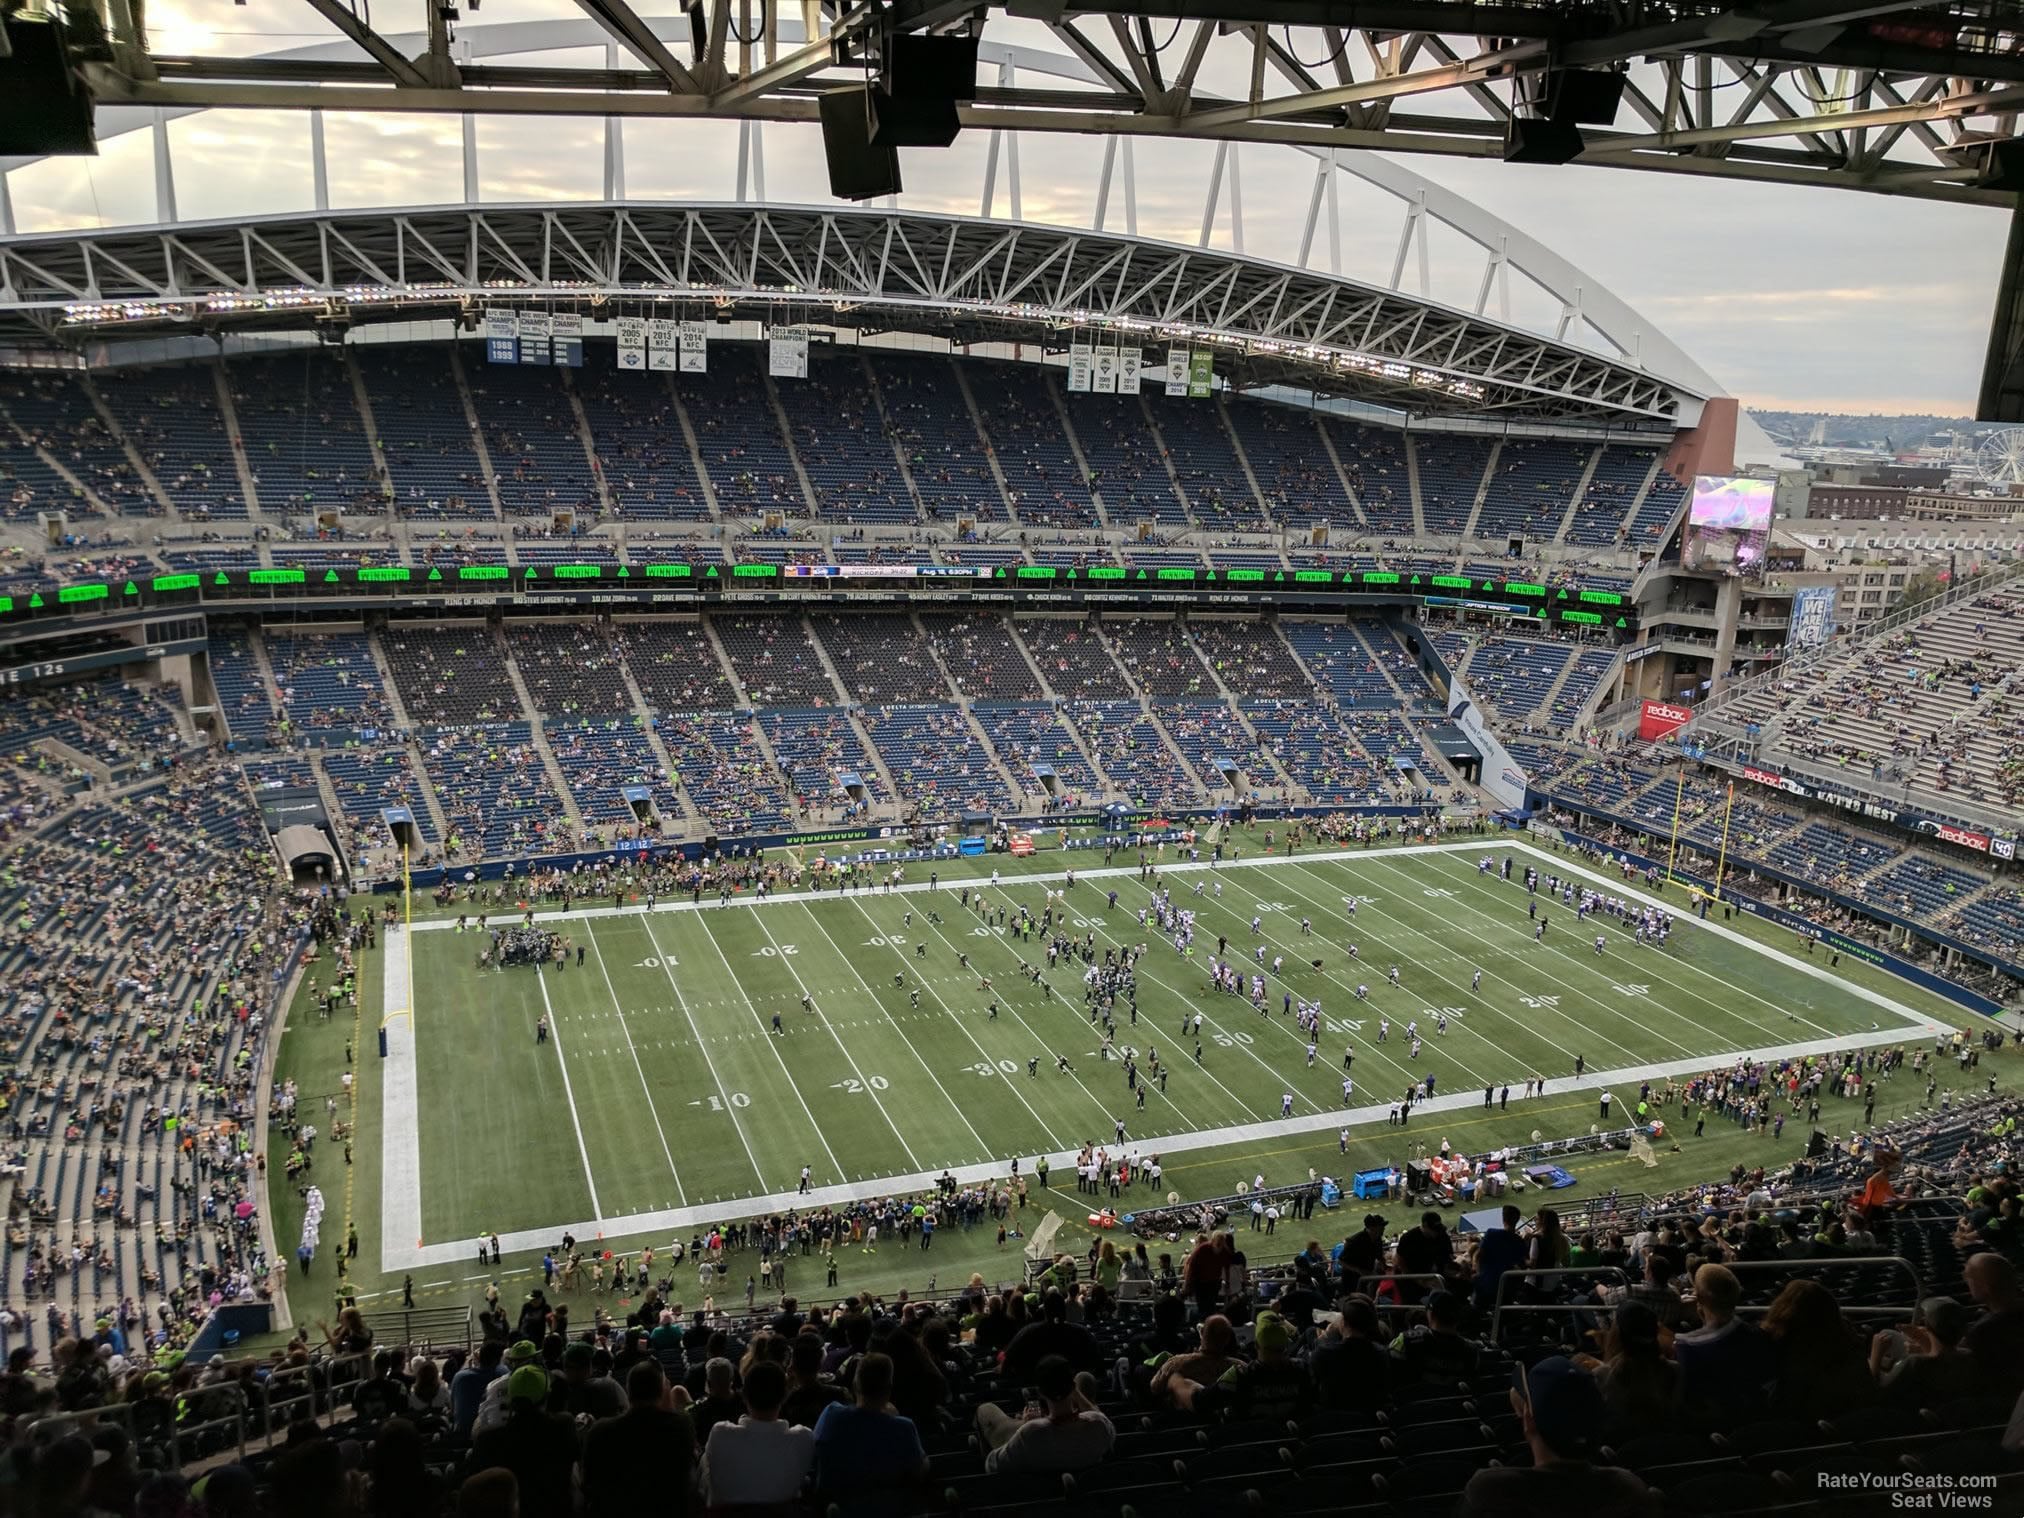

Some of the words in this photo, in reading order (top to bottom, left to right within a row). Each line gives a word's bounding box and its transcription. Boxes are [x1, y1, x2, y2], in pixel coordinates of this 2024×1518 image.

[622, 329, 640, 337] 2005
[653, 331, 672, 340] 2013
[684, 333, 702, 341] 2014
[460, 567, 508, 579] WINNING!
[555, 566, 600, 577] WINNING!
[646, 565, 690, 576] WINNING!
[734, 565, 776, 576] WINNING!
[1018, 568, 1055, 578] WINNING!
[1089, 569, 1125, 578] WINNING!
[1158, 570, 1194, 580] WINNING!
[1228, 571, 1264, 580] WINNING!
[1296, 572, 1332, 582] WINNING!
[1364, 573, 1399, 583] WINNING!
[1433, 577, 1471, 588] WINNING!
[1506, 584, 1545, 595] WINNING!
[1580, 593, 1621, 605] WINNING!
[1805, 600, 1824, 613] WE
[1562, 612, 1601, 624] WINNING!
[1802, 614, 1821, 625] ARE
[34, 664, 64, 677] 12s
[365, 729, 375, 738] 12
[1864, 803, 1898, 822] NEST
[621, 842, 630, 850] 12
[639, 840, 647, 849] 12
[1995, 842, 2011, 857] 40
[1423, 888, 1454, 897] 10
[1256, 902, 1289, 912] 30
[1073, 917, 1107, 928] 50
[973, 926, 1007, 937] 40
[870, 934, 907, 946] 30
[760, 945, 798, 957] 20
[643, 955, 680, 967] 10
[1612, 983, 1649, 997] 10
[1520, 995, 1559, 1008] 20
[1326, 1018, 1362, 1033] 40
[1212, 1032, 1254, 1047] 50
[973, 1059, 1019, 1076] 30
[842, 1075, 889, 1093] 20
[707, 1092, 751, 1111] 10
